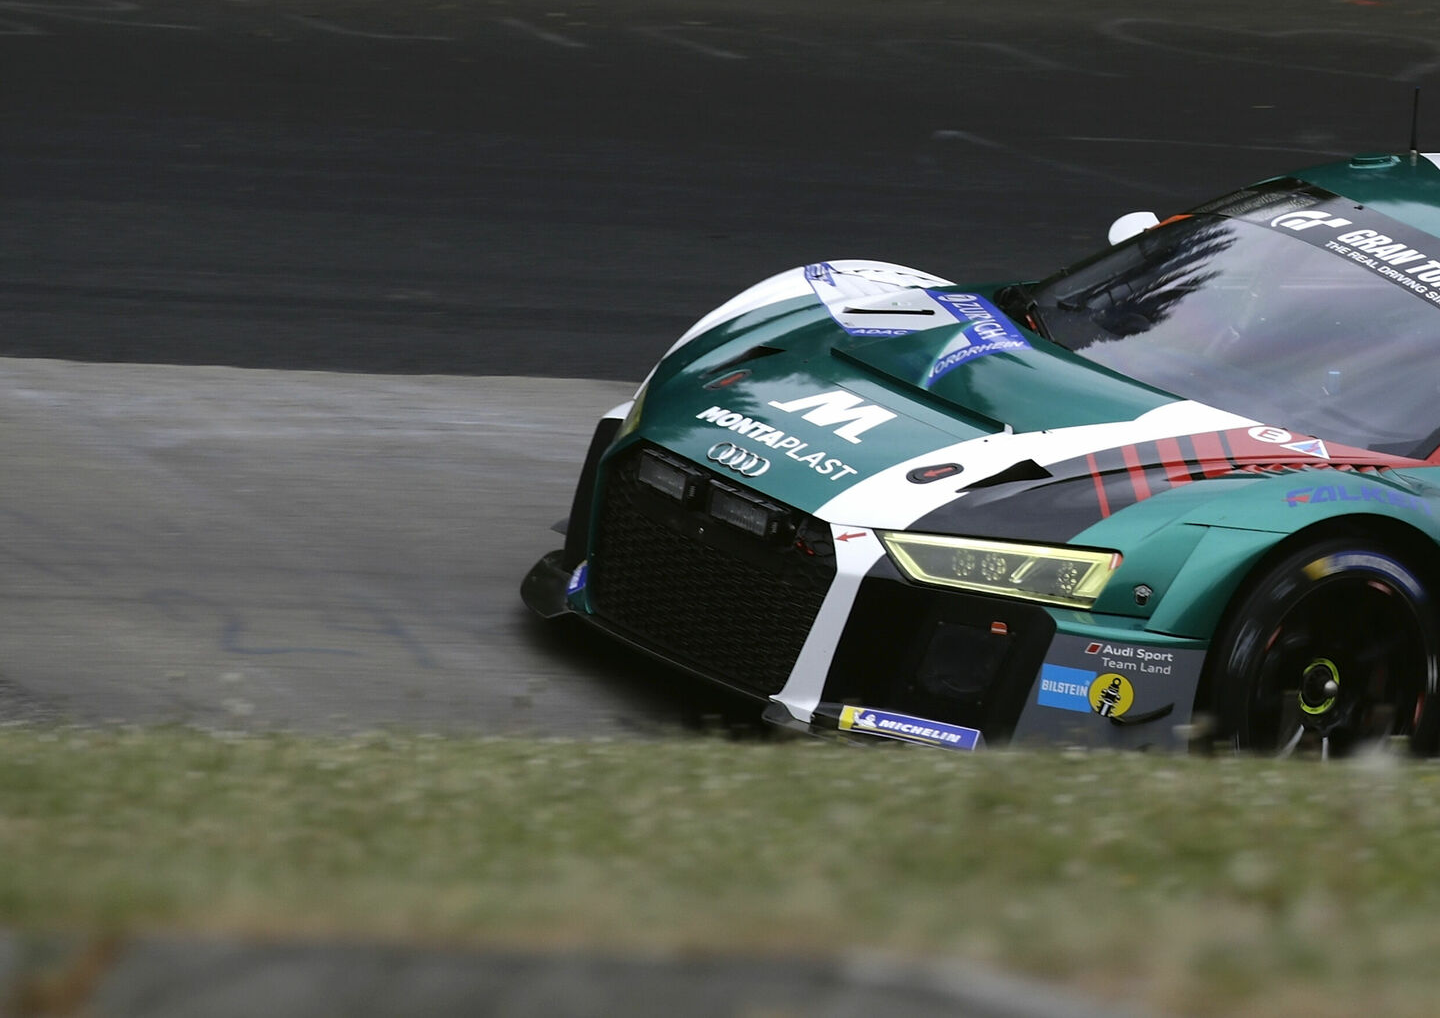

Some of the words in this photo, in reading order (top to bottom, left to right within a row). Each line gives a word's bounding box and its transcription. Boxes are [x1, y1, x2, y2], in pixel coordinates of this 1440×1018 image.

[1336, 228, 1428, 266] GRAN
[1324, 240, 1352, 255] THE
[1346, 250, 1379, 270] REAL
[1377, 265, 1429, 294] DRIVING
[695, 405, 858, 482] MONTAPLAST
[1101, 656, 1137, 671] Team
[1140, 662, 1172, 676] Land
[1102, 644, 1134, 657] Audi
[1136, 648, 1174, 662] Sport
[1041, 678, 1089, 697] BILSTEIN
[877, 718, 962, 744] MICHELIN
